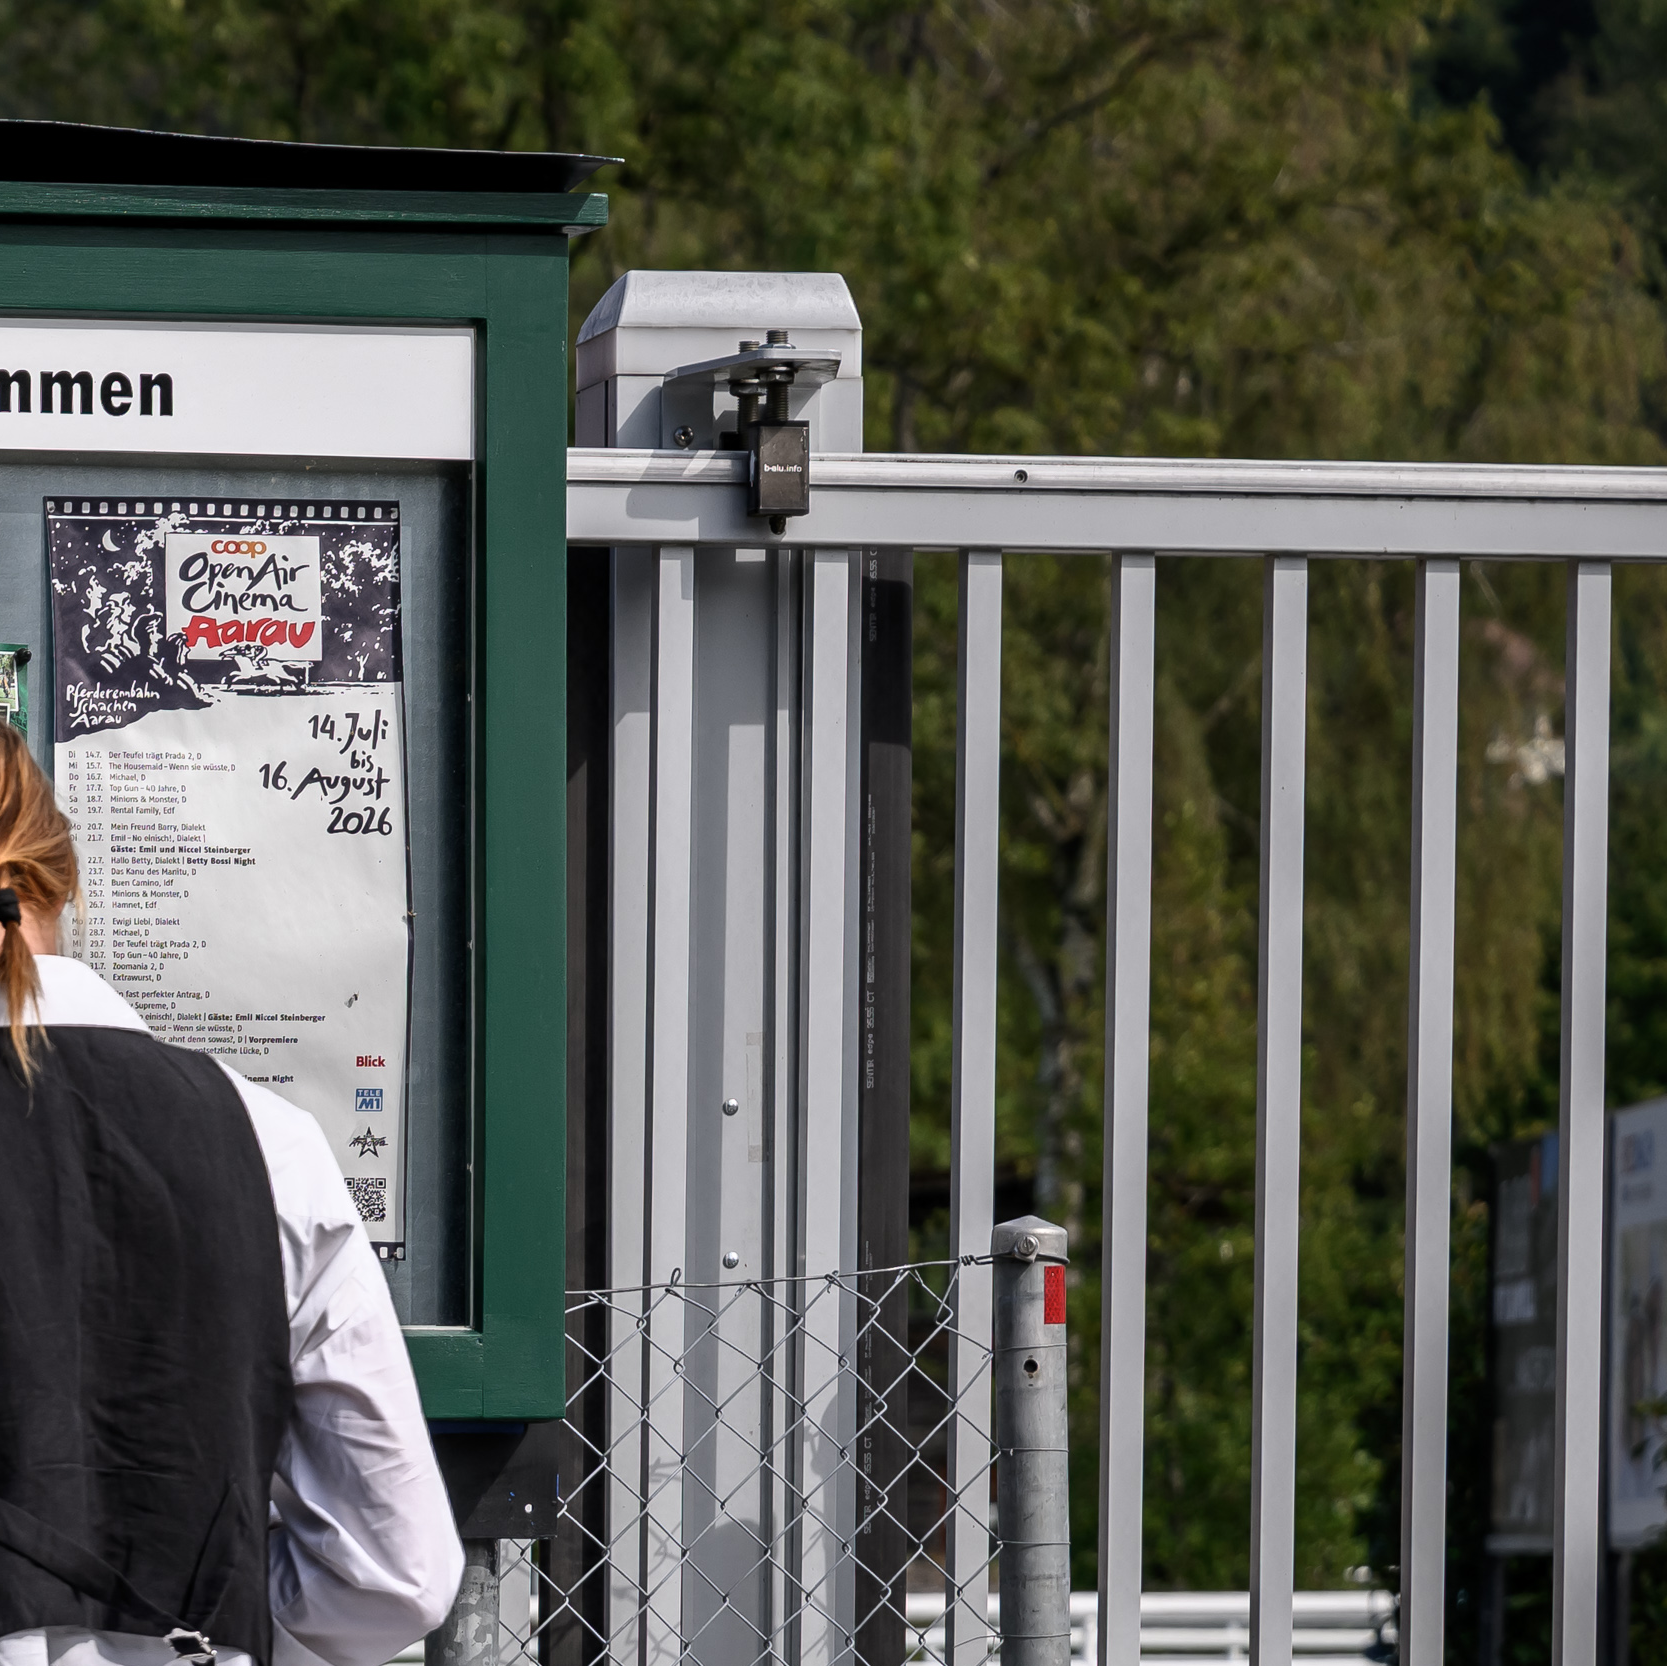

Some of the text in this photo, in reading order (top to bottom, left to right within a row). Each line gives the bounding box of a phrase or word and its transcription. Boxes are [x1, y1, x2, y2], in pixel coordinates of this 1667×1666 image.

[211, 540, 267, 559] coop
[181, 615, 316, 649] Aarau
[66, 680, 160, 708] Pferderennbahn
[69, 698, 137, 718] Schachen
[70, 713, 122, 728] Aarau
[308, 709, 389, 755] 14. Juli
[68, 750, 76, 758] Di
[85, 751, 102, 759] 14.7.
[108, 751, 121, 759] Der
[122, 751, 144, 759] Teufel
[145, 752, 164, 761] trägt
[350, 749, 374, 773] bis
[68, 761, 78, 769] Mi
[109, 762, 122, 770] The
[123, 762, 163, 770] Housemaid
[191, 763, 201, 771] sie
[203, 763, 230, 772] wüsste,
[69, 772, 139, 782] Do 16.7. Michael,
[69, 783, 77, 792] Fr
[86, 783, 103, 792] 17.7.
[109, 784, 122, 793] Top
[124, 784, 139, 792] Gun
[158, 785, 179, 793] Jahre,
[259, 761, 391, 805] 16. August
[69, 795, 78, 803] Sa
[87, 795, 103, 803] 18.7.
[148, 796, 180, 804] Monster,
[69, 806, 175, 816] So 19.7. Rental Family, Edf
[326, 806, 393, 836] 2026
[87, 822, 104, 831] 20.7.
[111, 823, 129, 831] Mein
[130, 823, 156, 831] Freund
[181, 823, 206, 831] Dialekt
[87, 833, 104, 842] 21.7.
[110, 834, 126, 842] Emil
[132, 834, 142, 842] No
[177, 834, 202, 842] Dialekt
[110, 845, 136, 853] Gäste:
[139, 845, 157, 853] Emil
[204, 845, 251, 855] Steinberger
[88, 856, 104, 864] 22.7.
[131, 856, 153, 866] Betty,
[186, 857, 208, 866] Betty
[210, 857, 231, 865] Bossi
[234, 857, 256, 866] Night
[88, 867, 189, 877] 23.7. Das Kanu des Manitu,
[88, 878, 105, 887] 24.7.
[111, 879, 130, 887] Buen
[132, 878, 162, 888] Camino,
[89, 901, 157, 910] 26.7. Hamnet, Edf
[88, 917, 105, 925] 27.7.
[112, 917, 132, 927] Ewigi
[155, 917, 180, 926] Dialekt
[112, 962, 148, 970] Zoomania
[112, 973, 154, 983] Extrawurst,
[125, 990, 203, 1000] fast perfekter Antrag,
[866, 990, 875, 1003] CT
[208, 1013, 326, 1023] Gäste: Emil Steinberger
[248, 1035, 298, 1045] Vorpremiere
[356, 1054, 386, 1068] Blick
[358, 1089, 381, 1097] TELE
[358, 1098, 380, 1109] M1
